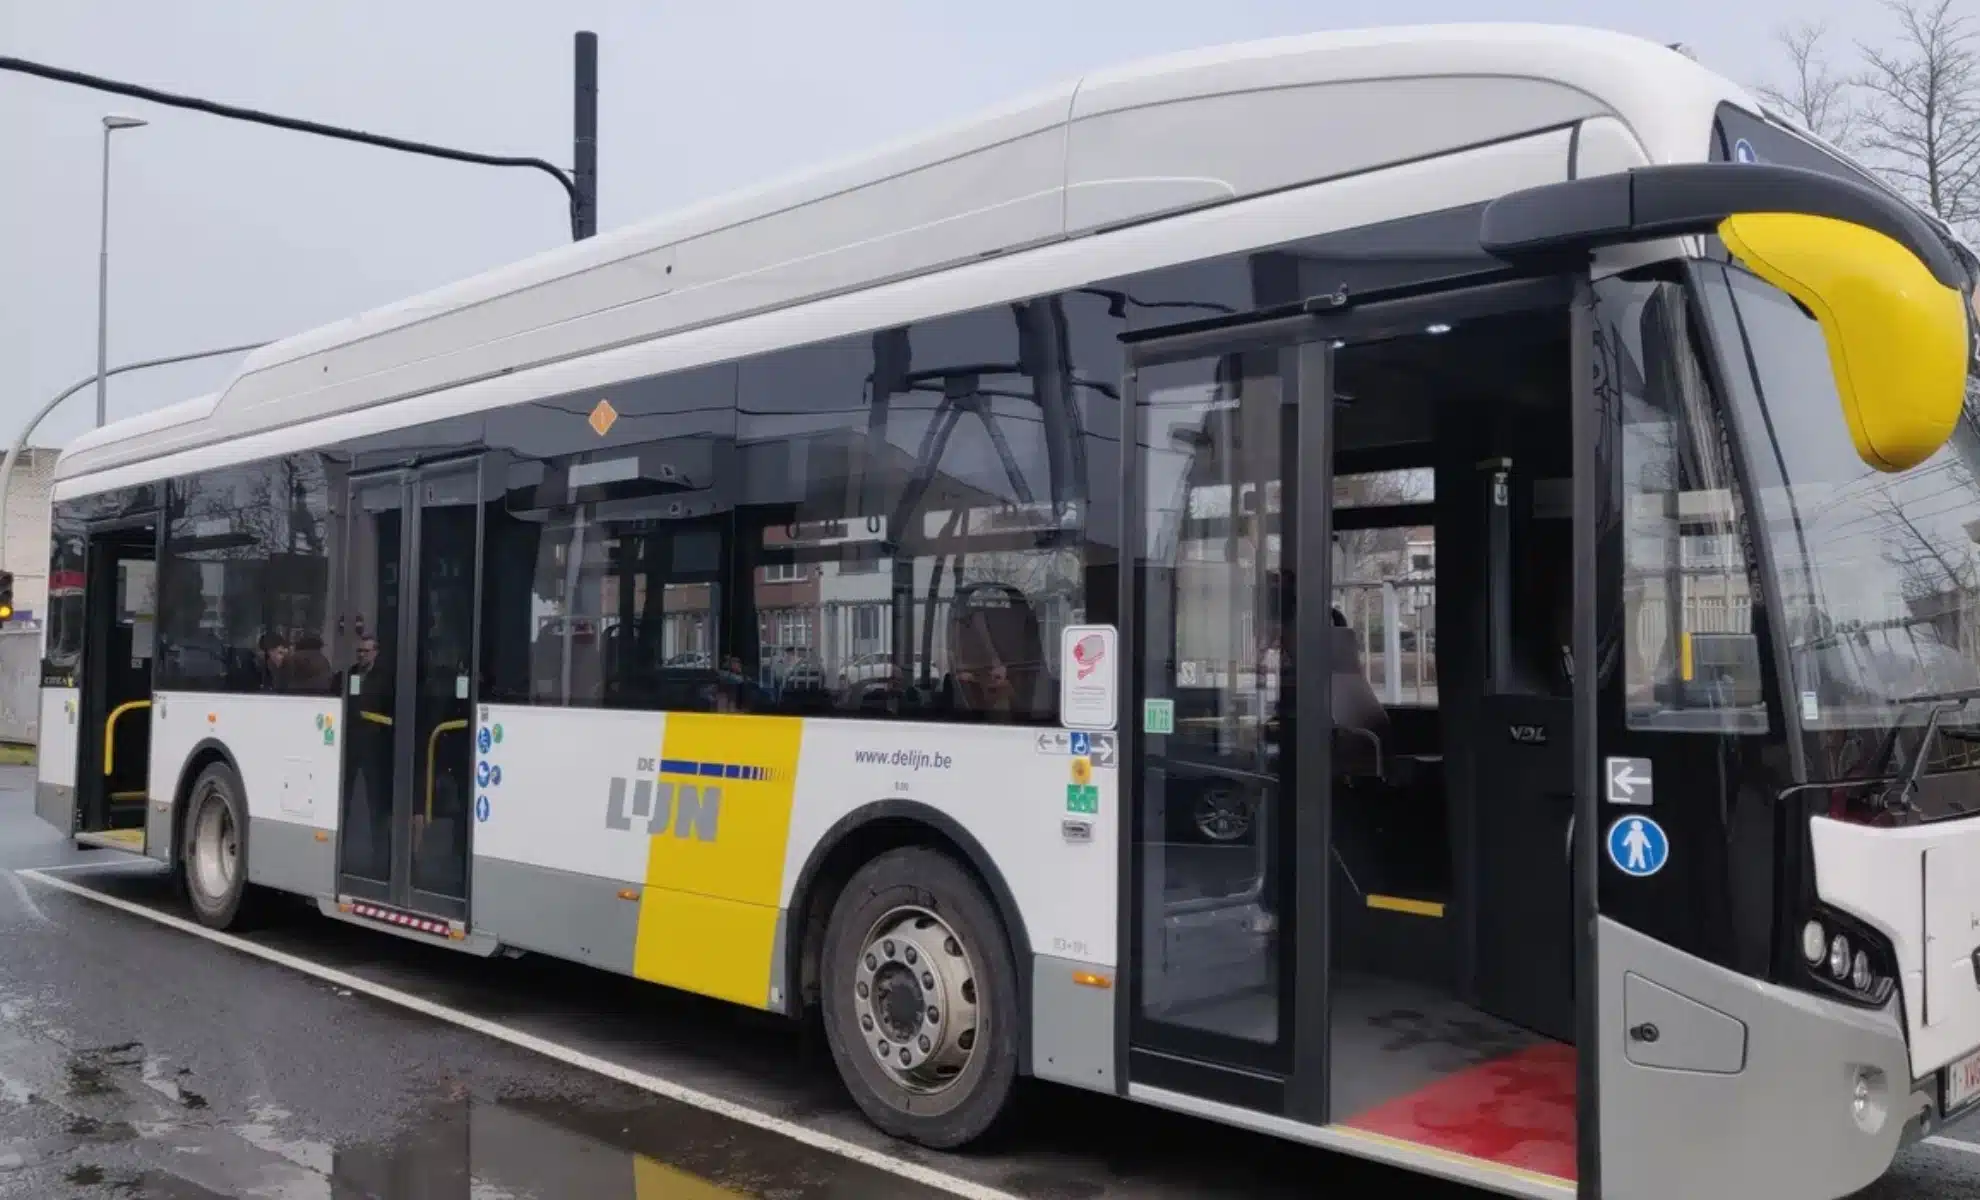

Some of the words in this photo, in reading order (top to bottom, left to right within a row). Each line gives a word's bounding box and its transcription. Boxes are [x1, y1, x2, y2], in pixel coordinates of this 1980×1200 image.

[1509, 725, 1546, 741] VDL
[637, 758, 656, 771] DE
[854, 749, 952, 771] www.delijn.be
[605, 777, 721, 842] LIJN
